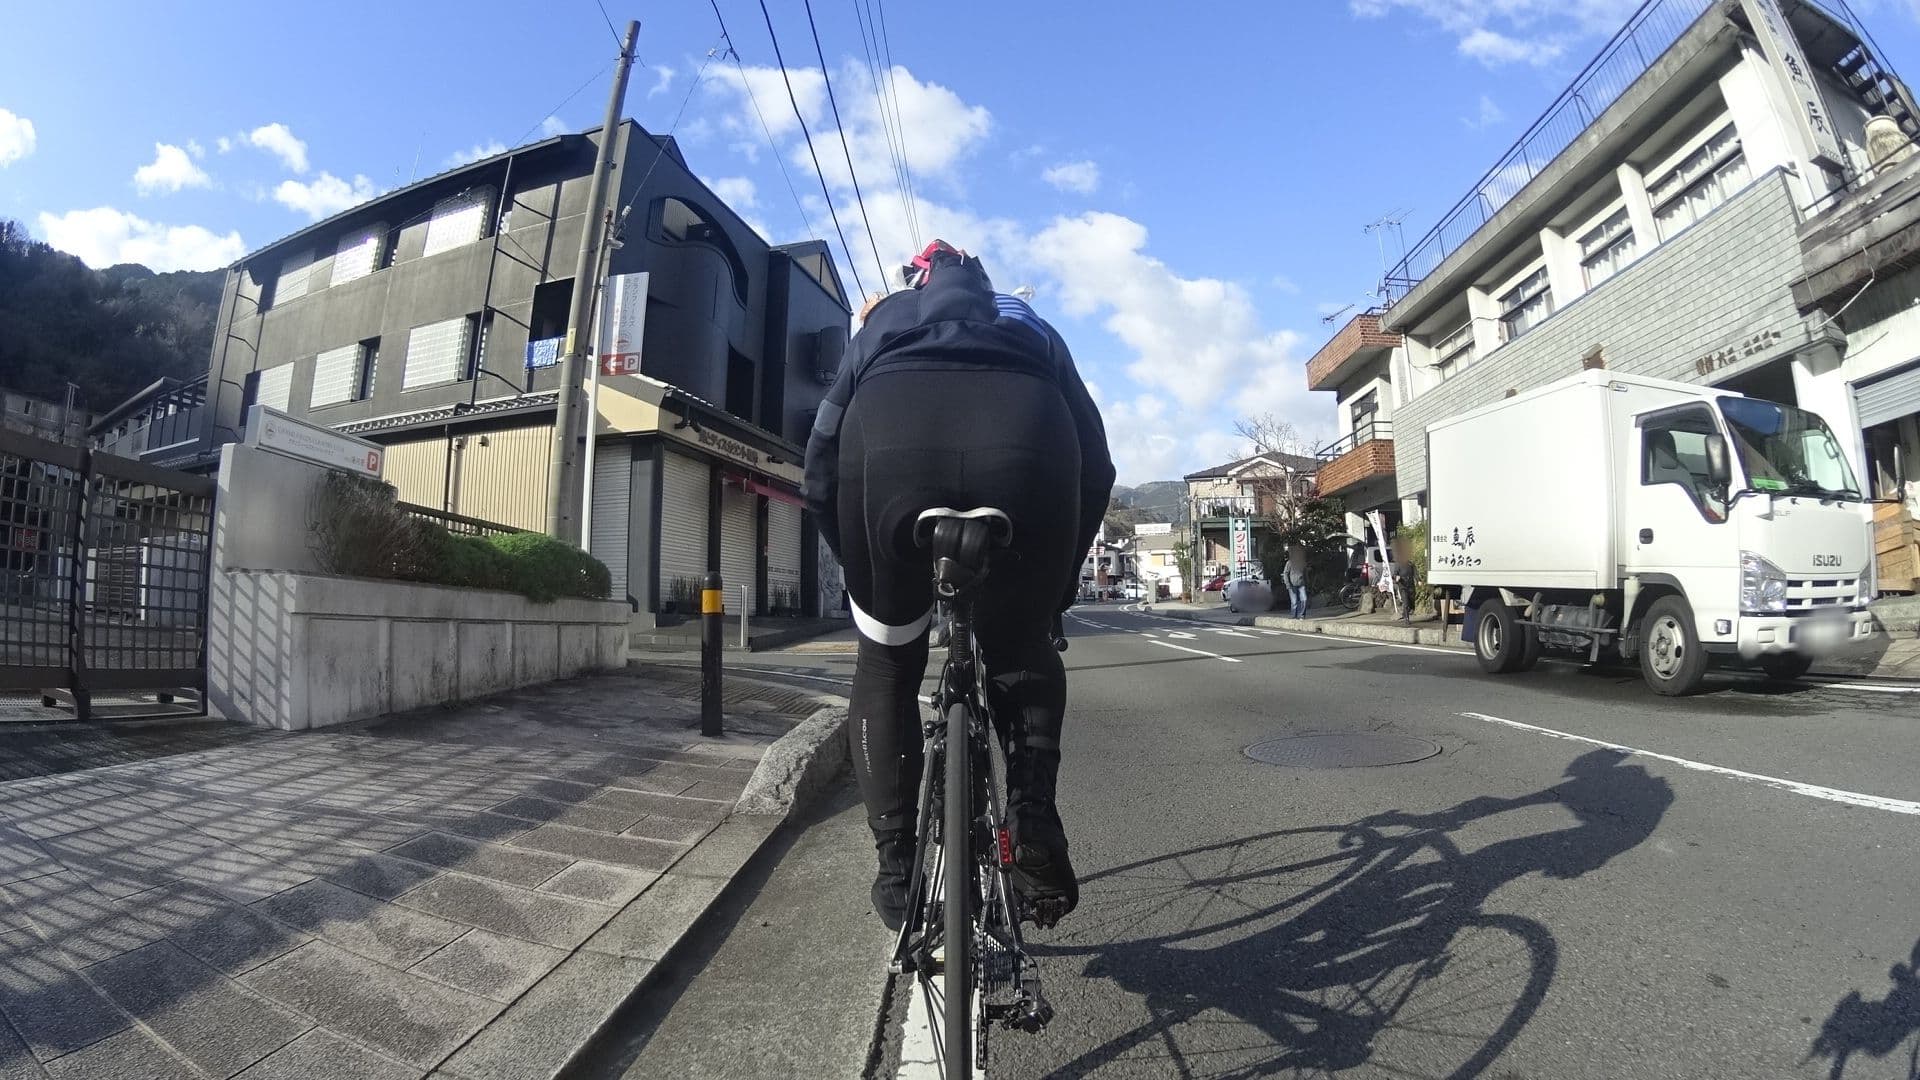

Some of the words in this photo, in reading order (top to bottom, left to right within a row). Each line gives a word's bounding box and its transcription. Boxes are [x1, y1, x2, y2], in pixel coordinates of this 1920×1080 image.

[1784, 52, 1831, 135] 魚辰
[628, 358, 636, 367] P
[369, 454, 377, 468] P
[1812, 554, 1842, 567] ISUZU
